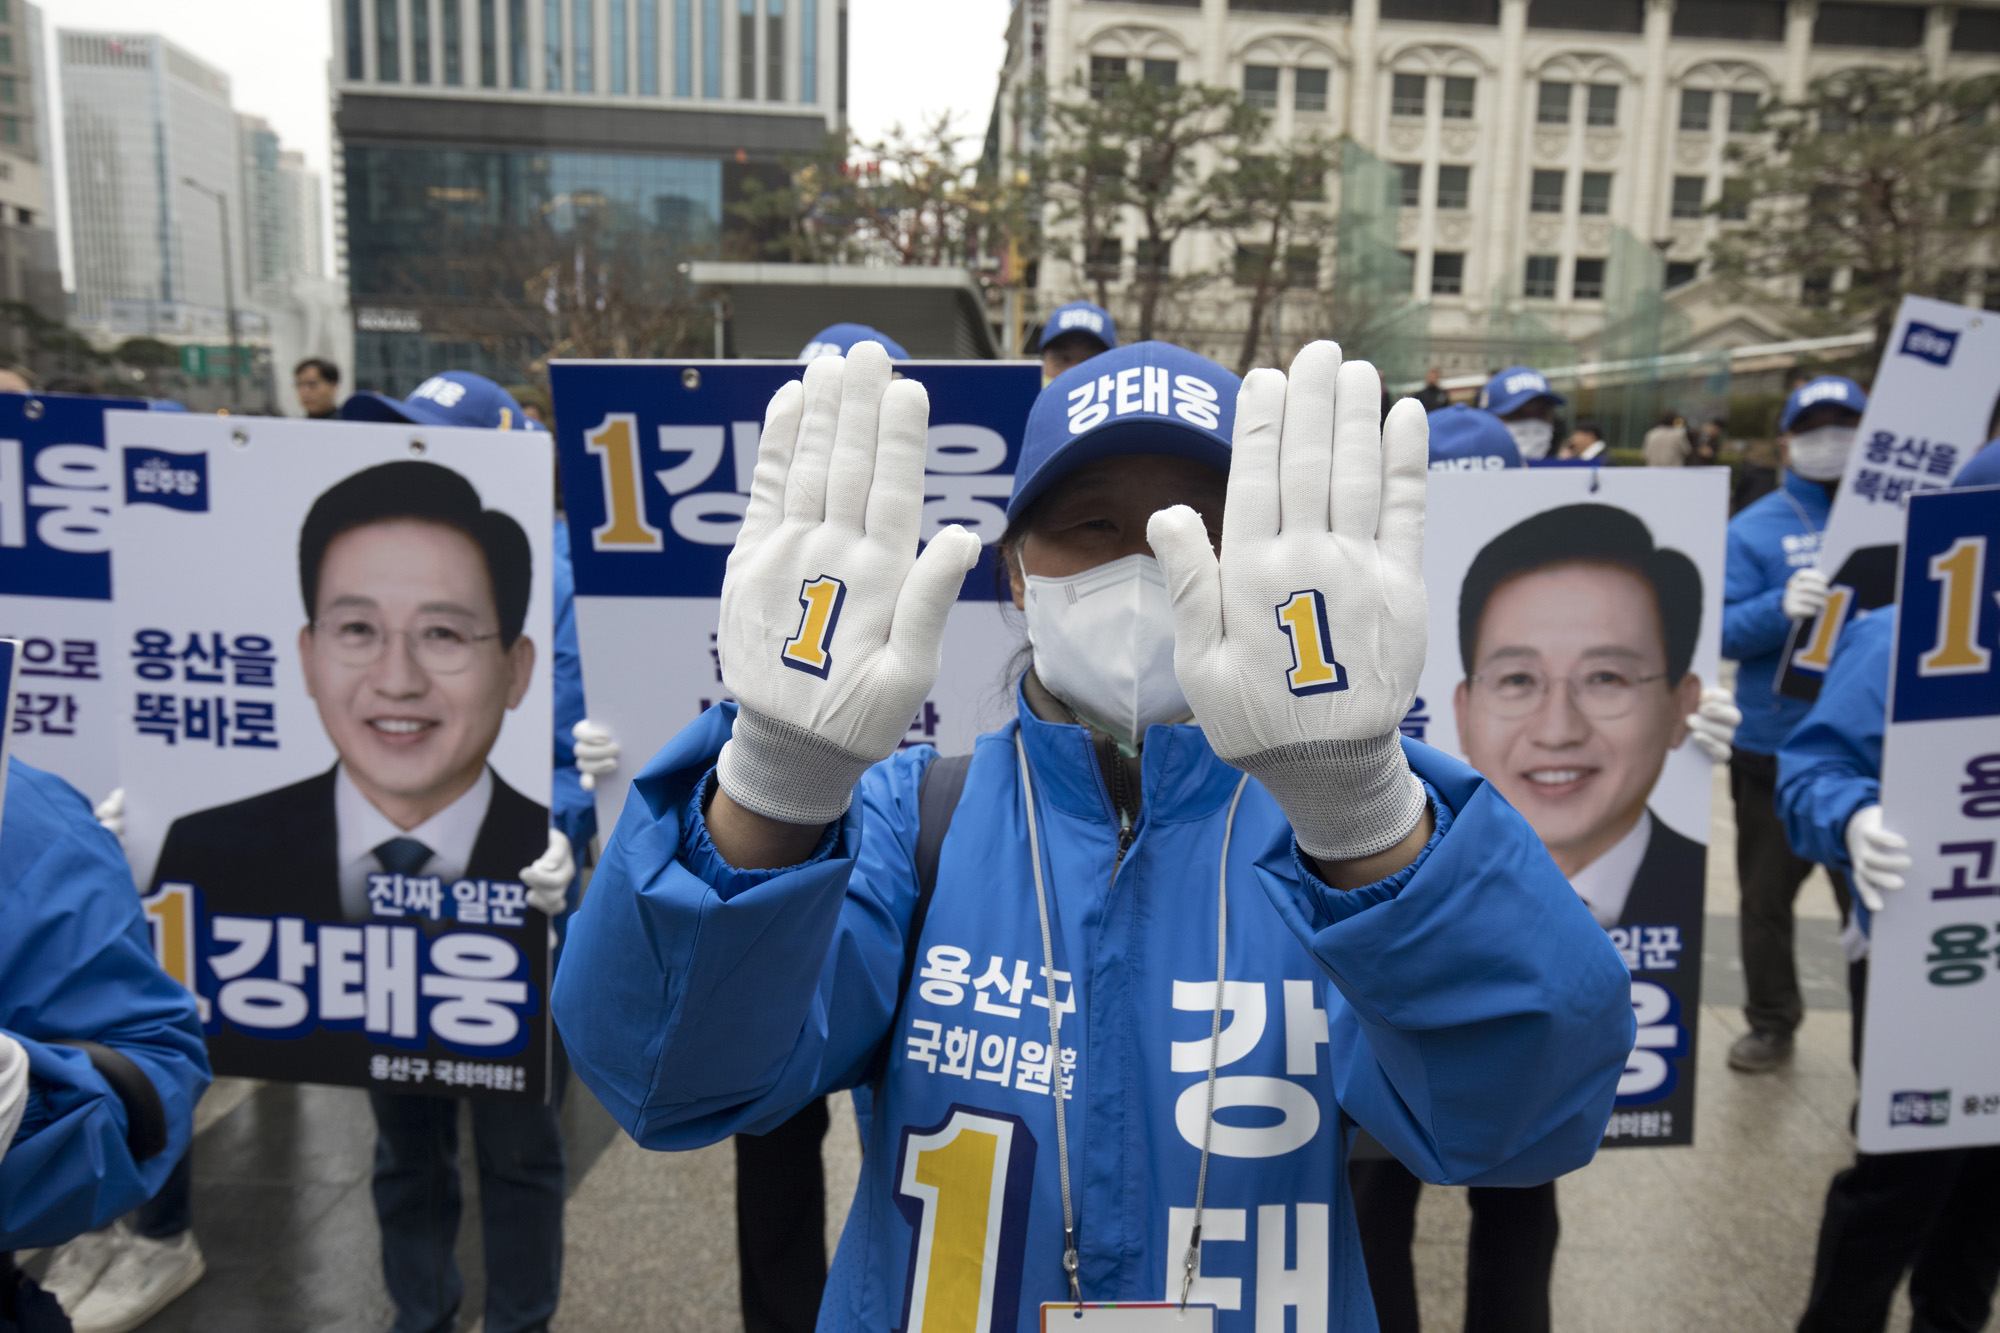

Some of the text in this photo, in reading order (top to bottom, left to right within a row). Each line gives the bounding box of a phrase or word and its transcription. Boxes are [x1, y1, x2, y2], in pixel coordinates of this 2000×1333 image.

[1067, 365, 1221, 435] 강태웅
[584, 413, 1014, 552] 1 강웅
[781, 574, 847, 680] 1
[1276, 589, 1349, 697] 1
[1791, 583, 1855, 674] 1
[1917, 535, 1991, 678] 1
[131, 628, 278, 689] 용산을
[132, 692, 280, 750] 똑바로
[367, 872, 529, 927] 진짜 일꾼
[207, 914, 529, 1047] 강태웅
[919, 944, 1077, 1030] 용산구
[369, 1054, 431, 1084] 용산구
[892, 1102, 1038, 1333] 1
